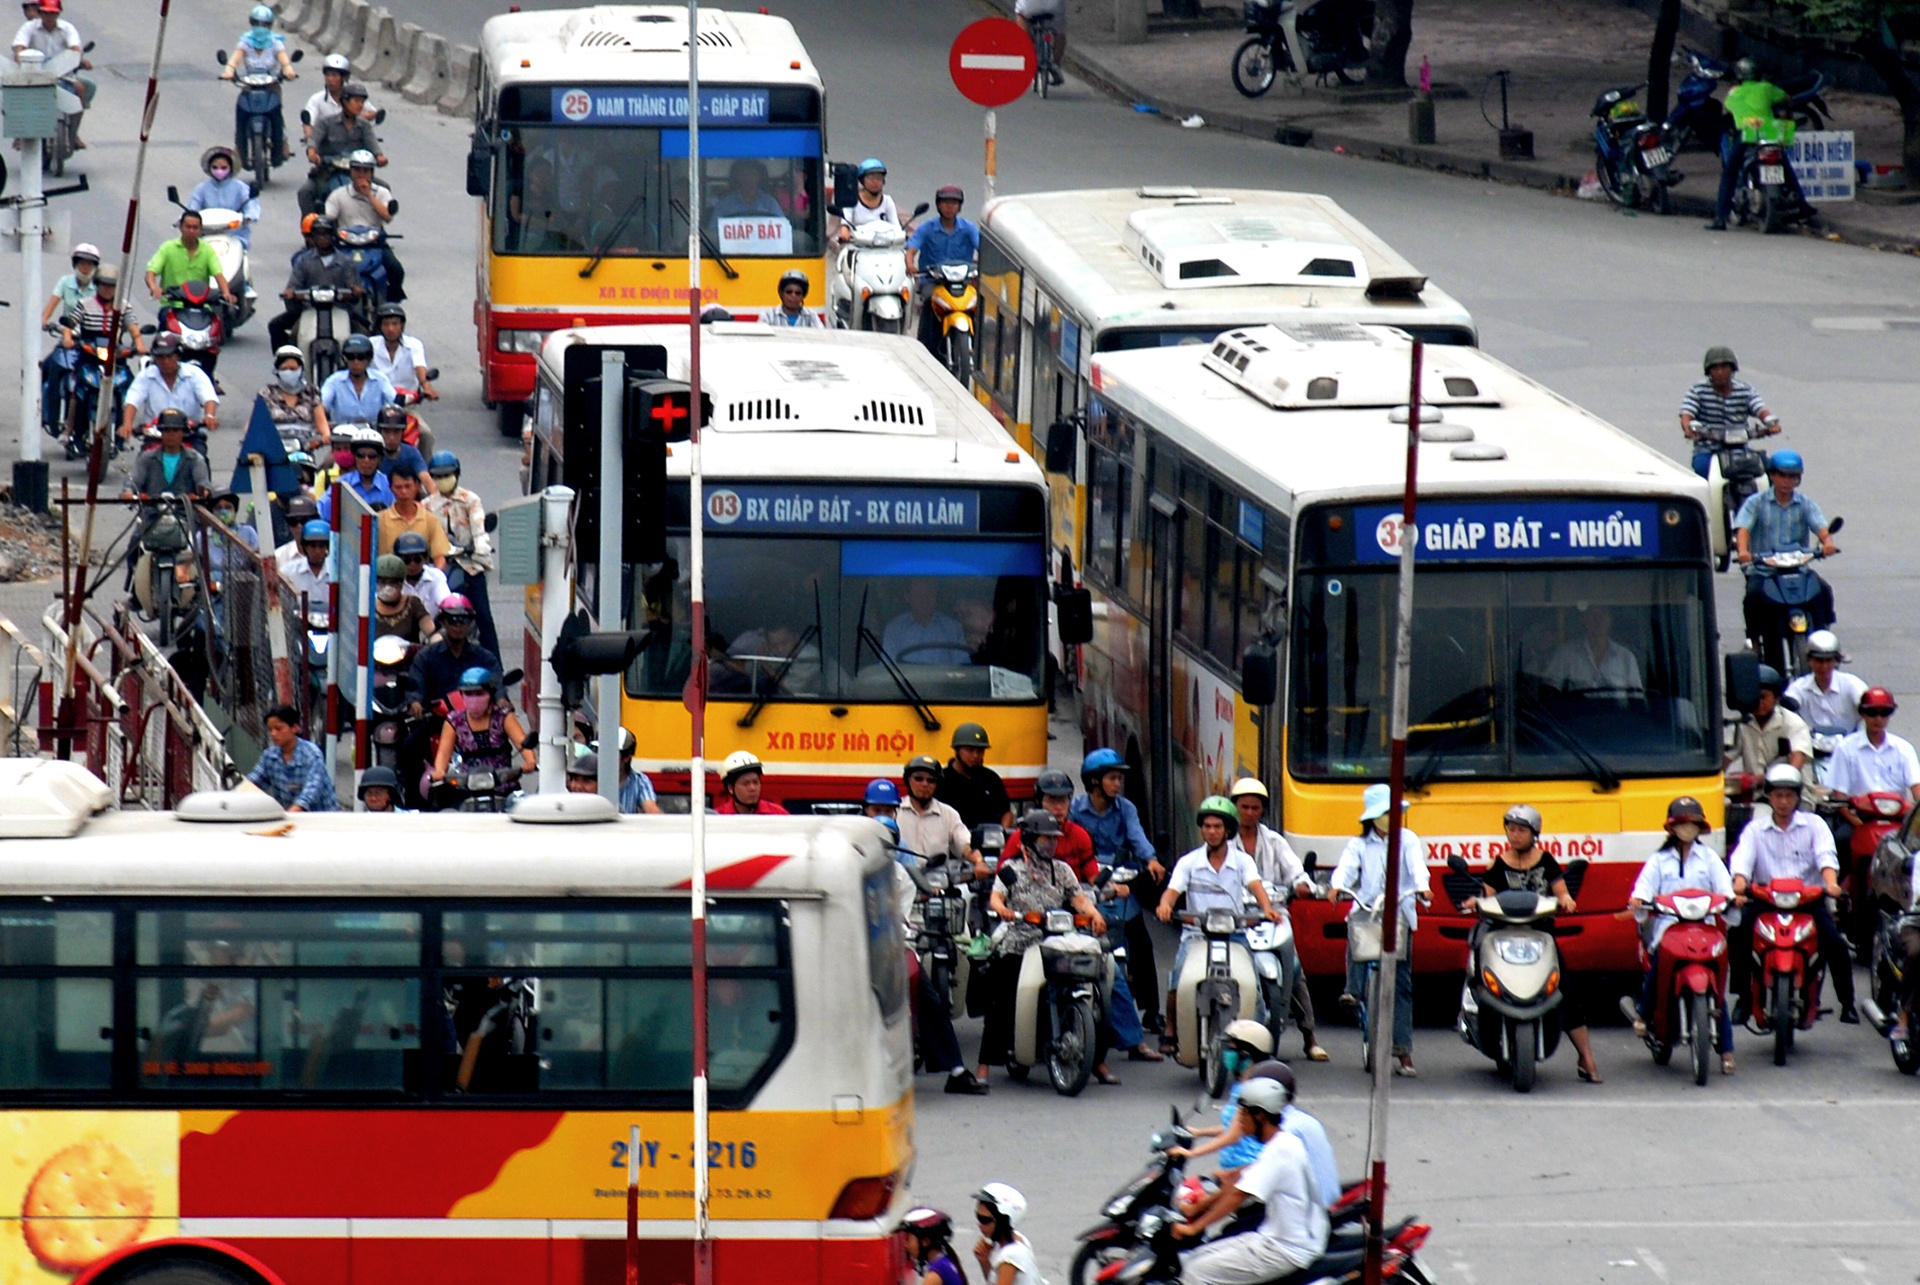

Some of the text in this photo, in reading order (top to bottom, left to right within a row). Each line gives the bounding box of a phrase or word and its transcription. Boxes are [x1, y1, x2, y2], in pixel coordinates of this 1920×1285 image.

[565, 95, 588, 114] 25
[597, 97, 624, 116] NAM
[669, 97, 700, 116] LON
[711, 93, 738, 116] GIÁP
[711, 495, 738, 516] 03
[746, 498, 769, 521] BX
[774, 494, 814, 522] GIÁP
[818, 495, 851, 523] BÁT
[867, 500, 890, 523] BX
[895, 501, 923, 523] GIA
[927, 497, 964, 525] LÂM
[1425, 517, 1486, 550] GIÁP
[1494, 516, 1543, 549] BÁT
[799, 732, 836, 750] BUS
[843, 729, 870, 752] HÀ
[876, 729, 914, 757] NỘI
[1458, 842, 1481, 859] XE
[1568, 835, 1603, 861] NỘI
[610, 1141, 660, 1168] 2Y
